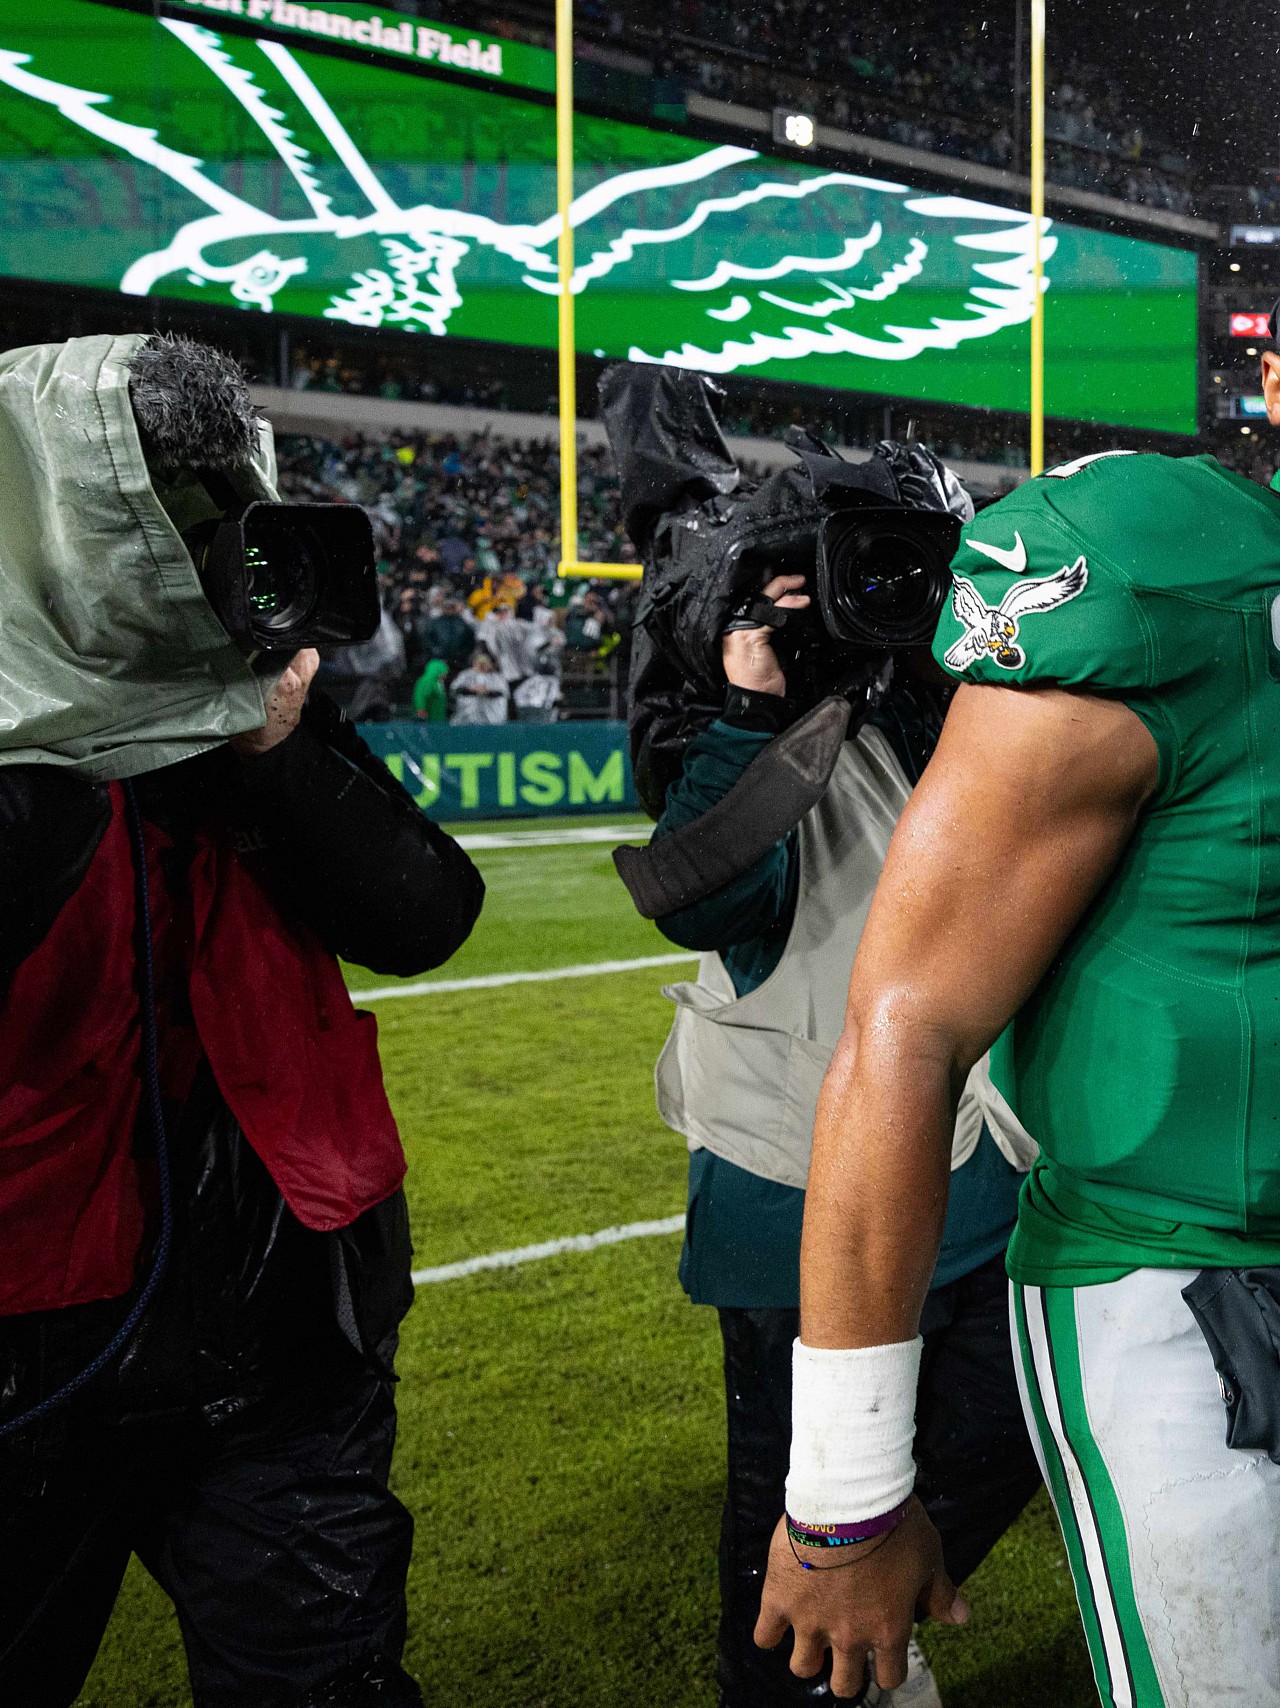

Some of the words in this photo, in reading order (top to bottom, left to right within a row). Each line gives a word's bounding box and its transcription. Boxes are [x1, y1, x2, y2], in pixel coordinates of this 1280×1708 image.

[247, 0, 414, 55] Financial
[416, 26, 502, 75] Field
[384, 751, 625, 808] UTISM
